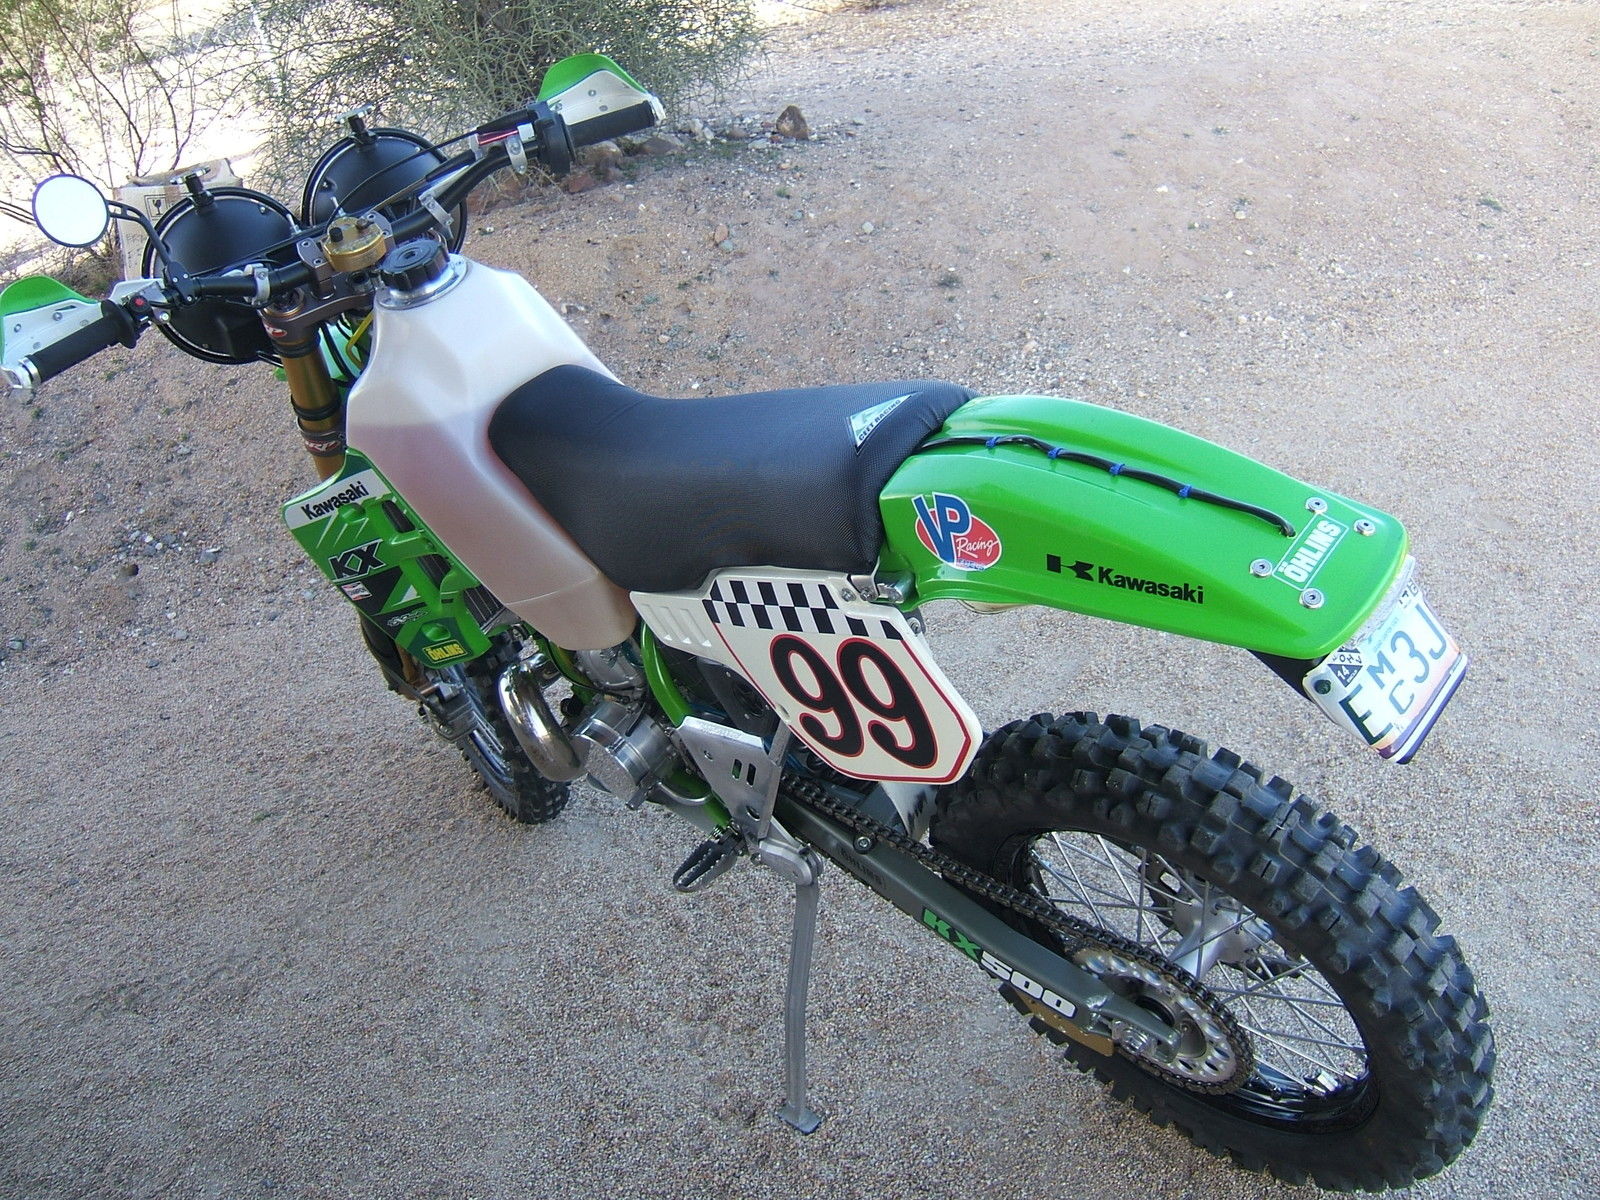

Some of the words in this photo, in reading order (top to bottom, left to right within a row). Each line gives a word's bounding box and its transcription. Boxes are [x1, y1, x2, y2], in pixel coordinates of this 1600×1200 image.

[301, 481, 370, 520] Kawasaki
[912, 492, 972, 564] VP
[955, 537, 1000, 558] Racing
[329, 539, 386, 581] KX
[1278, 519, 1342, 583] ÖHLINS
[1098, 566, 1204, 604] Kawasaki
[769, 633, 938, 769] 99
